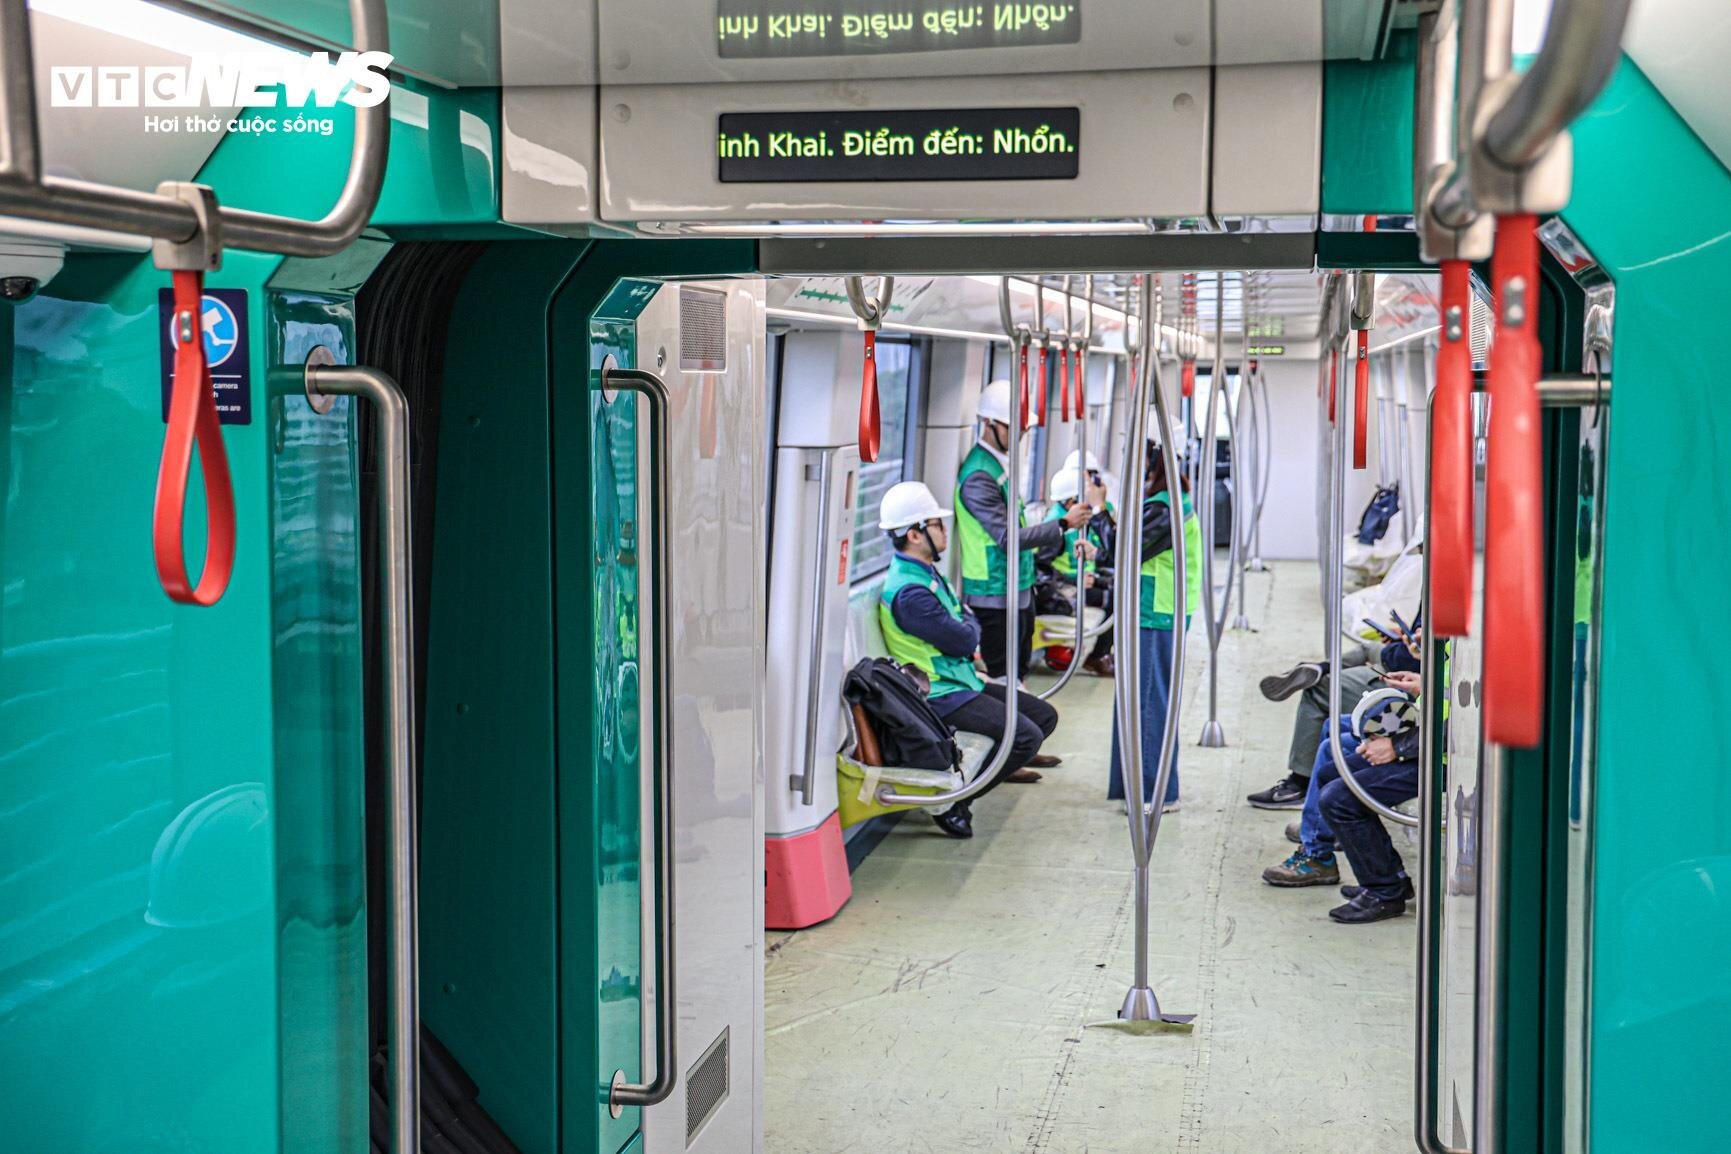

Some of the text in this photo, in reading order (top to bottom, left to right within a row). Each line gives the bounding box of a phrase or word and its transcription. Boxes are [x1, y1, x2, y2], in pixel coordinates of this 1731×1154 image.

[768, 131, 834, 158] Khai.
[842, 127, 914, 156] Điểm
[923, 126, 983, 155] đến:
[993, 124, 1074, 154] Nhổn.
